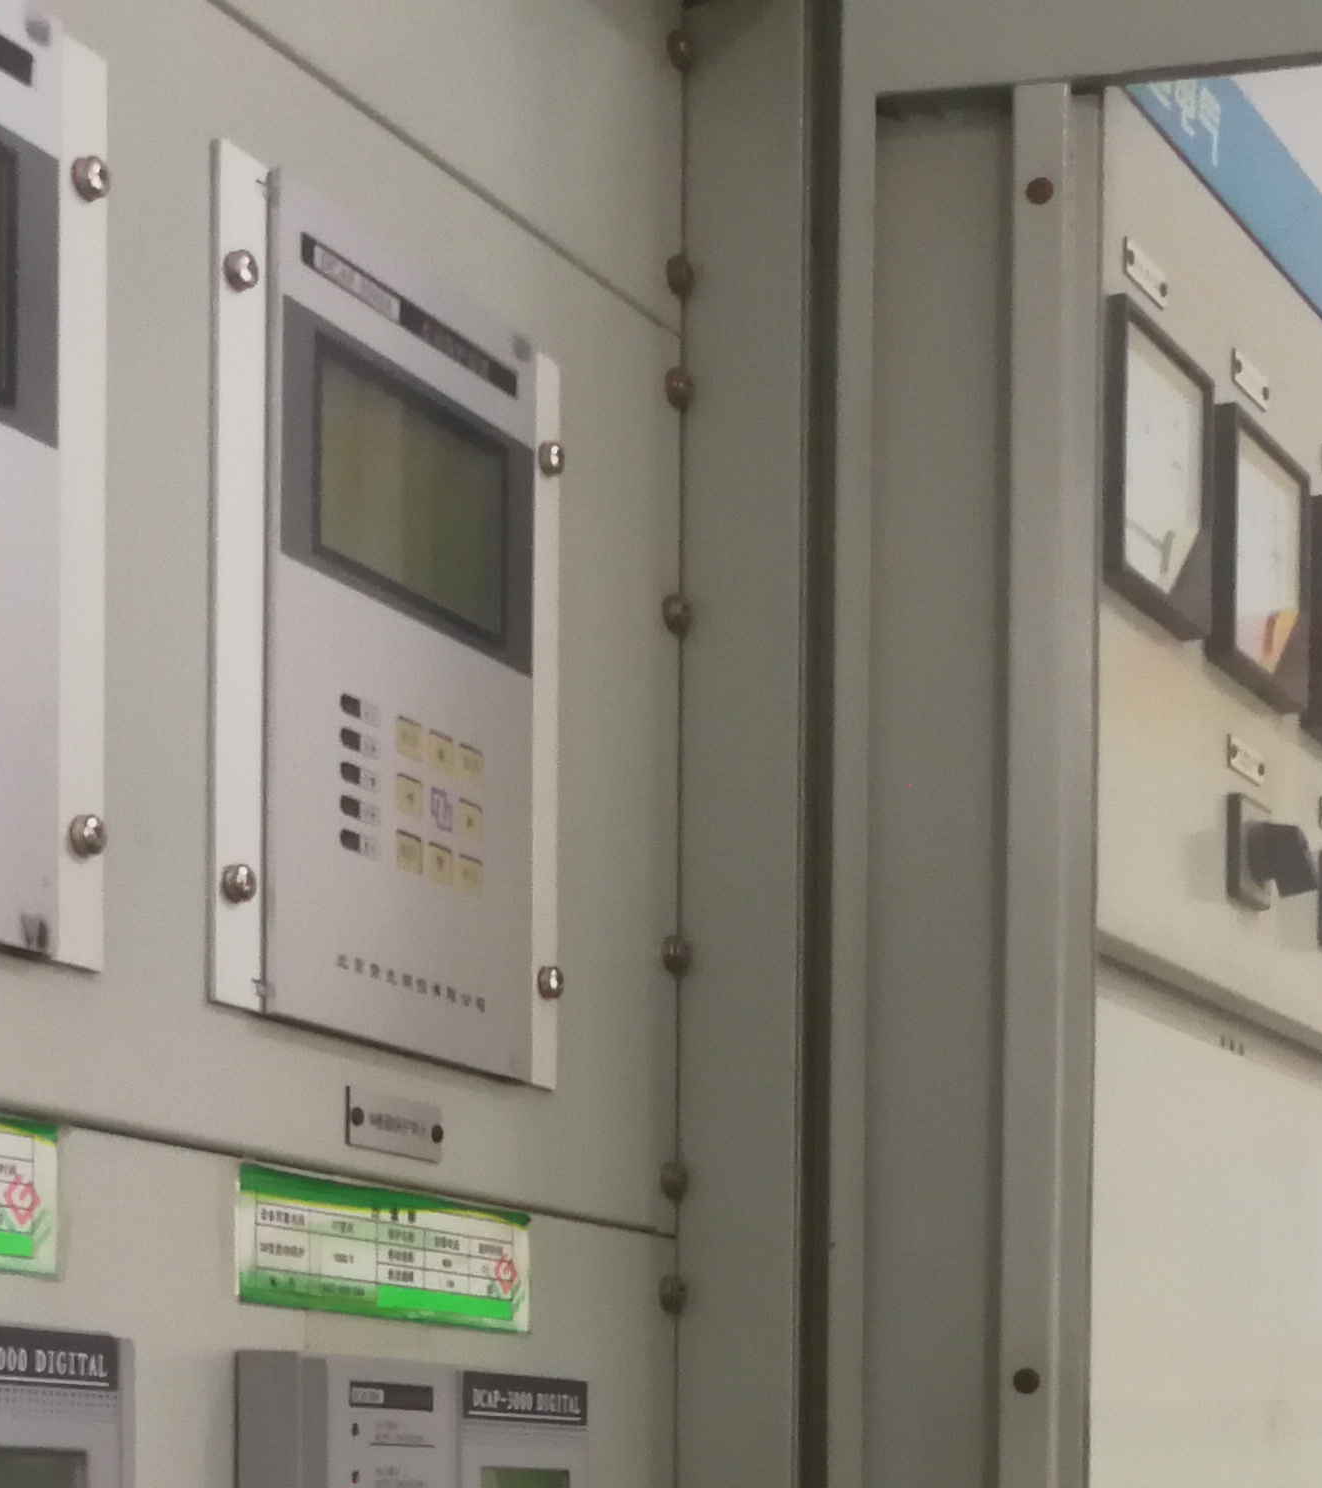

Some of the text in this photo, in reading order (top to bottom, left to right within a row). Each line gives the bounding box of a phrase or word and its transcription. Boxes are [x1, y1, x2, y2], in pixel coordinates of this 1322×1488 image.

[33, 1350, 109, 1378] DIGITAL
[472, 1388, 581, 1414] DCAP-3000 DIGITAL
